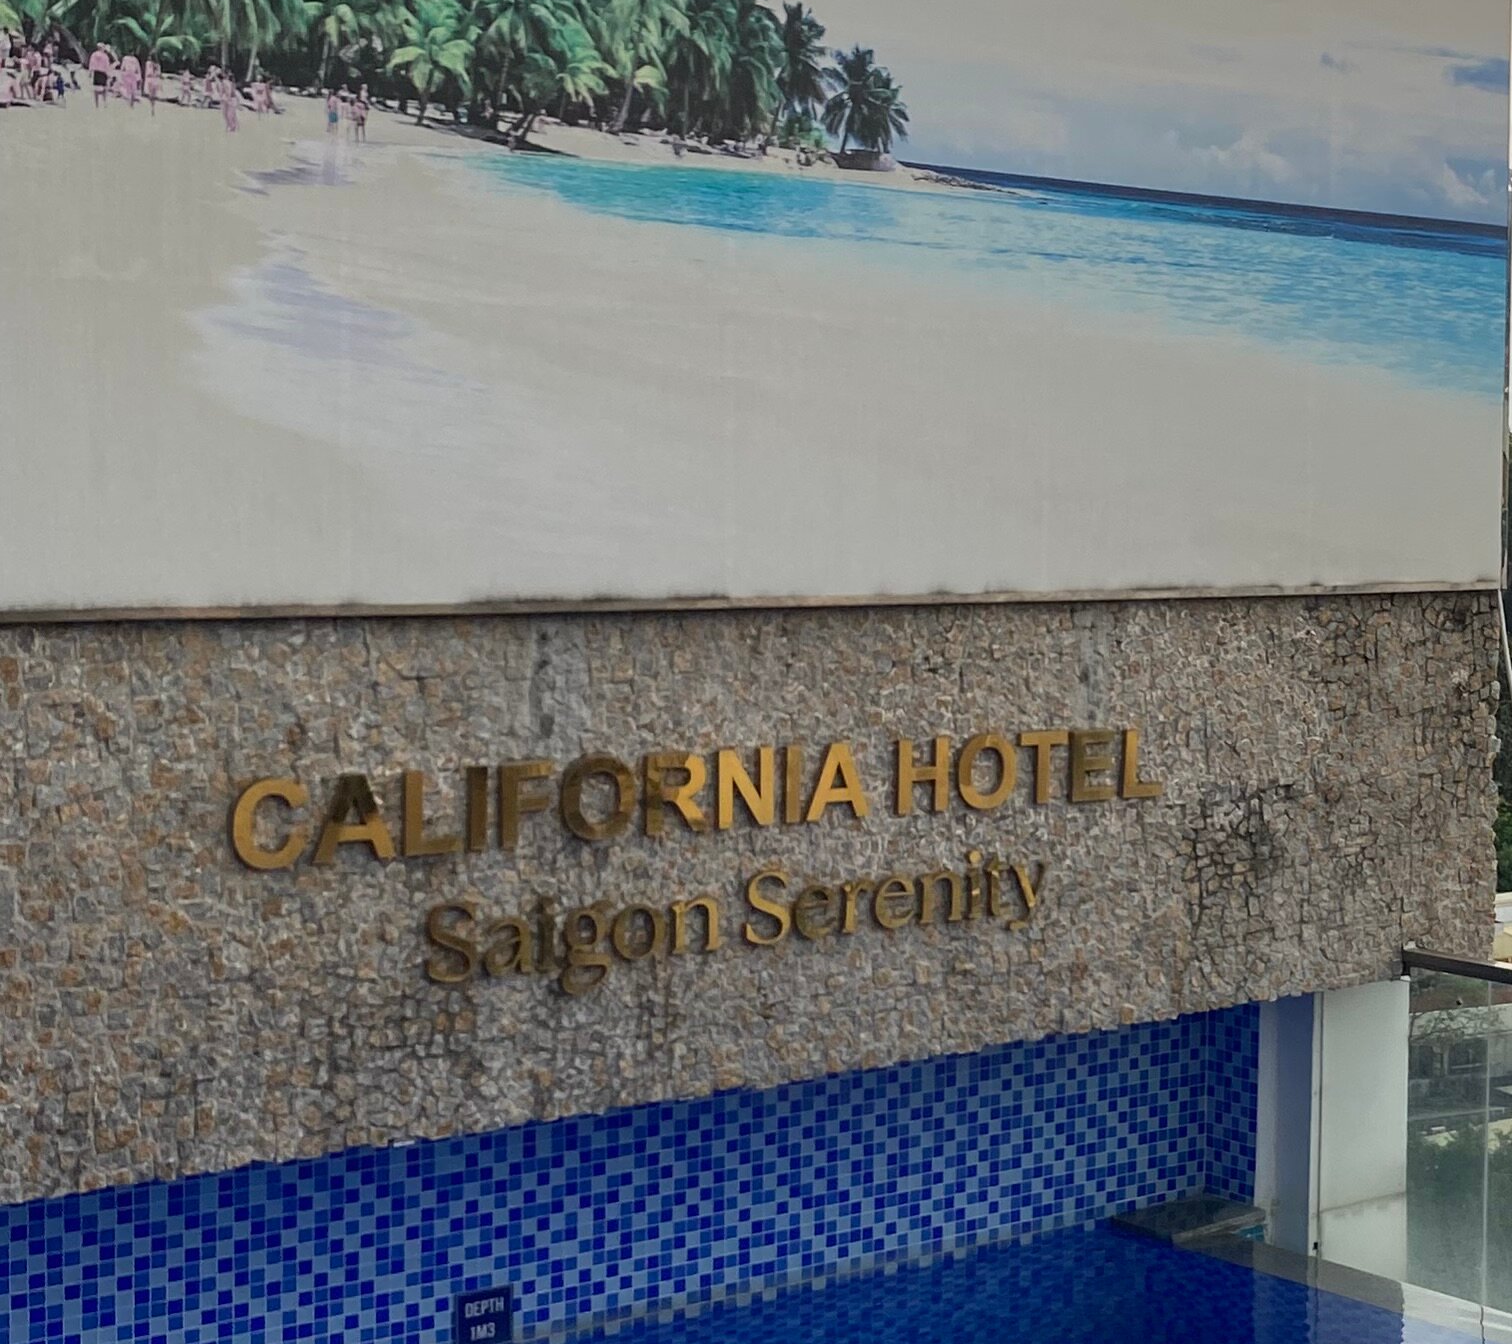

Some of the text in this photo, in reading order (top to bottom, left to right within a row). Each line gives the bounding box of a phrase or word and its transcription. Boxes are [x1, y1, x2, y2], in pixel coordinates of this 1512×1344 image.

[231, 728, 1164, 871] CALIFORNIA HOTEL
[424, 850, 1045, 996] Saigon Serenity
[465, 1296, 505, 1319] DEPTH
[470, 1322, 496, 1341] 1M3
